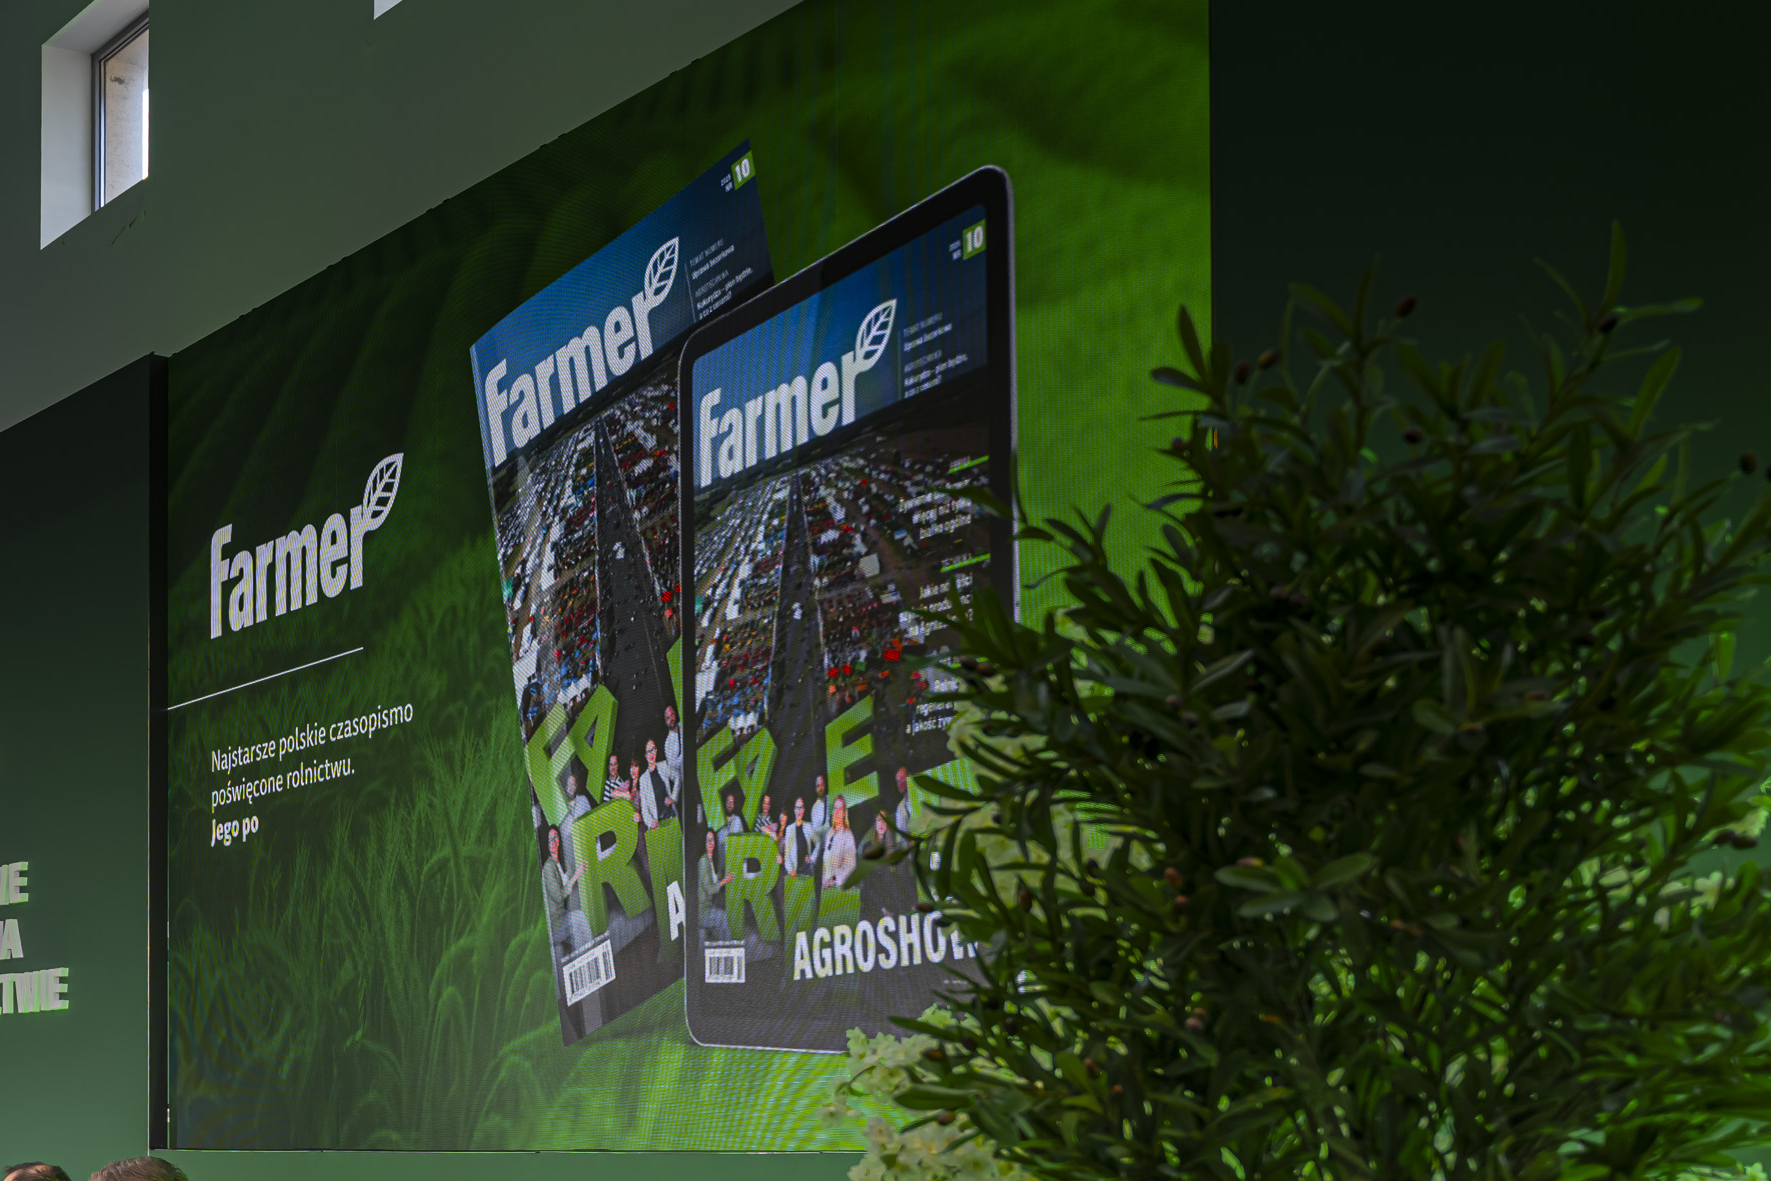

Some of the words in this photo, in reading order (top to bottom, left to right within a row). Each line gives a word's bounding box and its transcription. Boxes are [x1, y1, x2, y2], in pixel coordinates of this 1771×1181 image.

[735, 158, 750, 183] 10
[967, 225, 983, 252] 10
[484, 289, 656, 467] Farmer
[700, 350, 861, 487] Farmer
[210, 500, 370, 640] Farmer
[211, 738, 276, 774] Najstarsze
[279, 723, 326, 763] polskie
[329, 703, 414, 742] czasopismo
[211, 776, 283, 813] poświęcone
[286, 758, 355, 790] rolnictwu.
[211, 818, 239, 847] Jego
[242, 815, 259, 840] po
